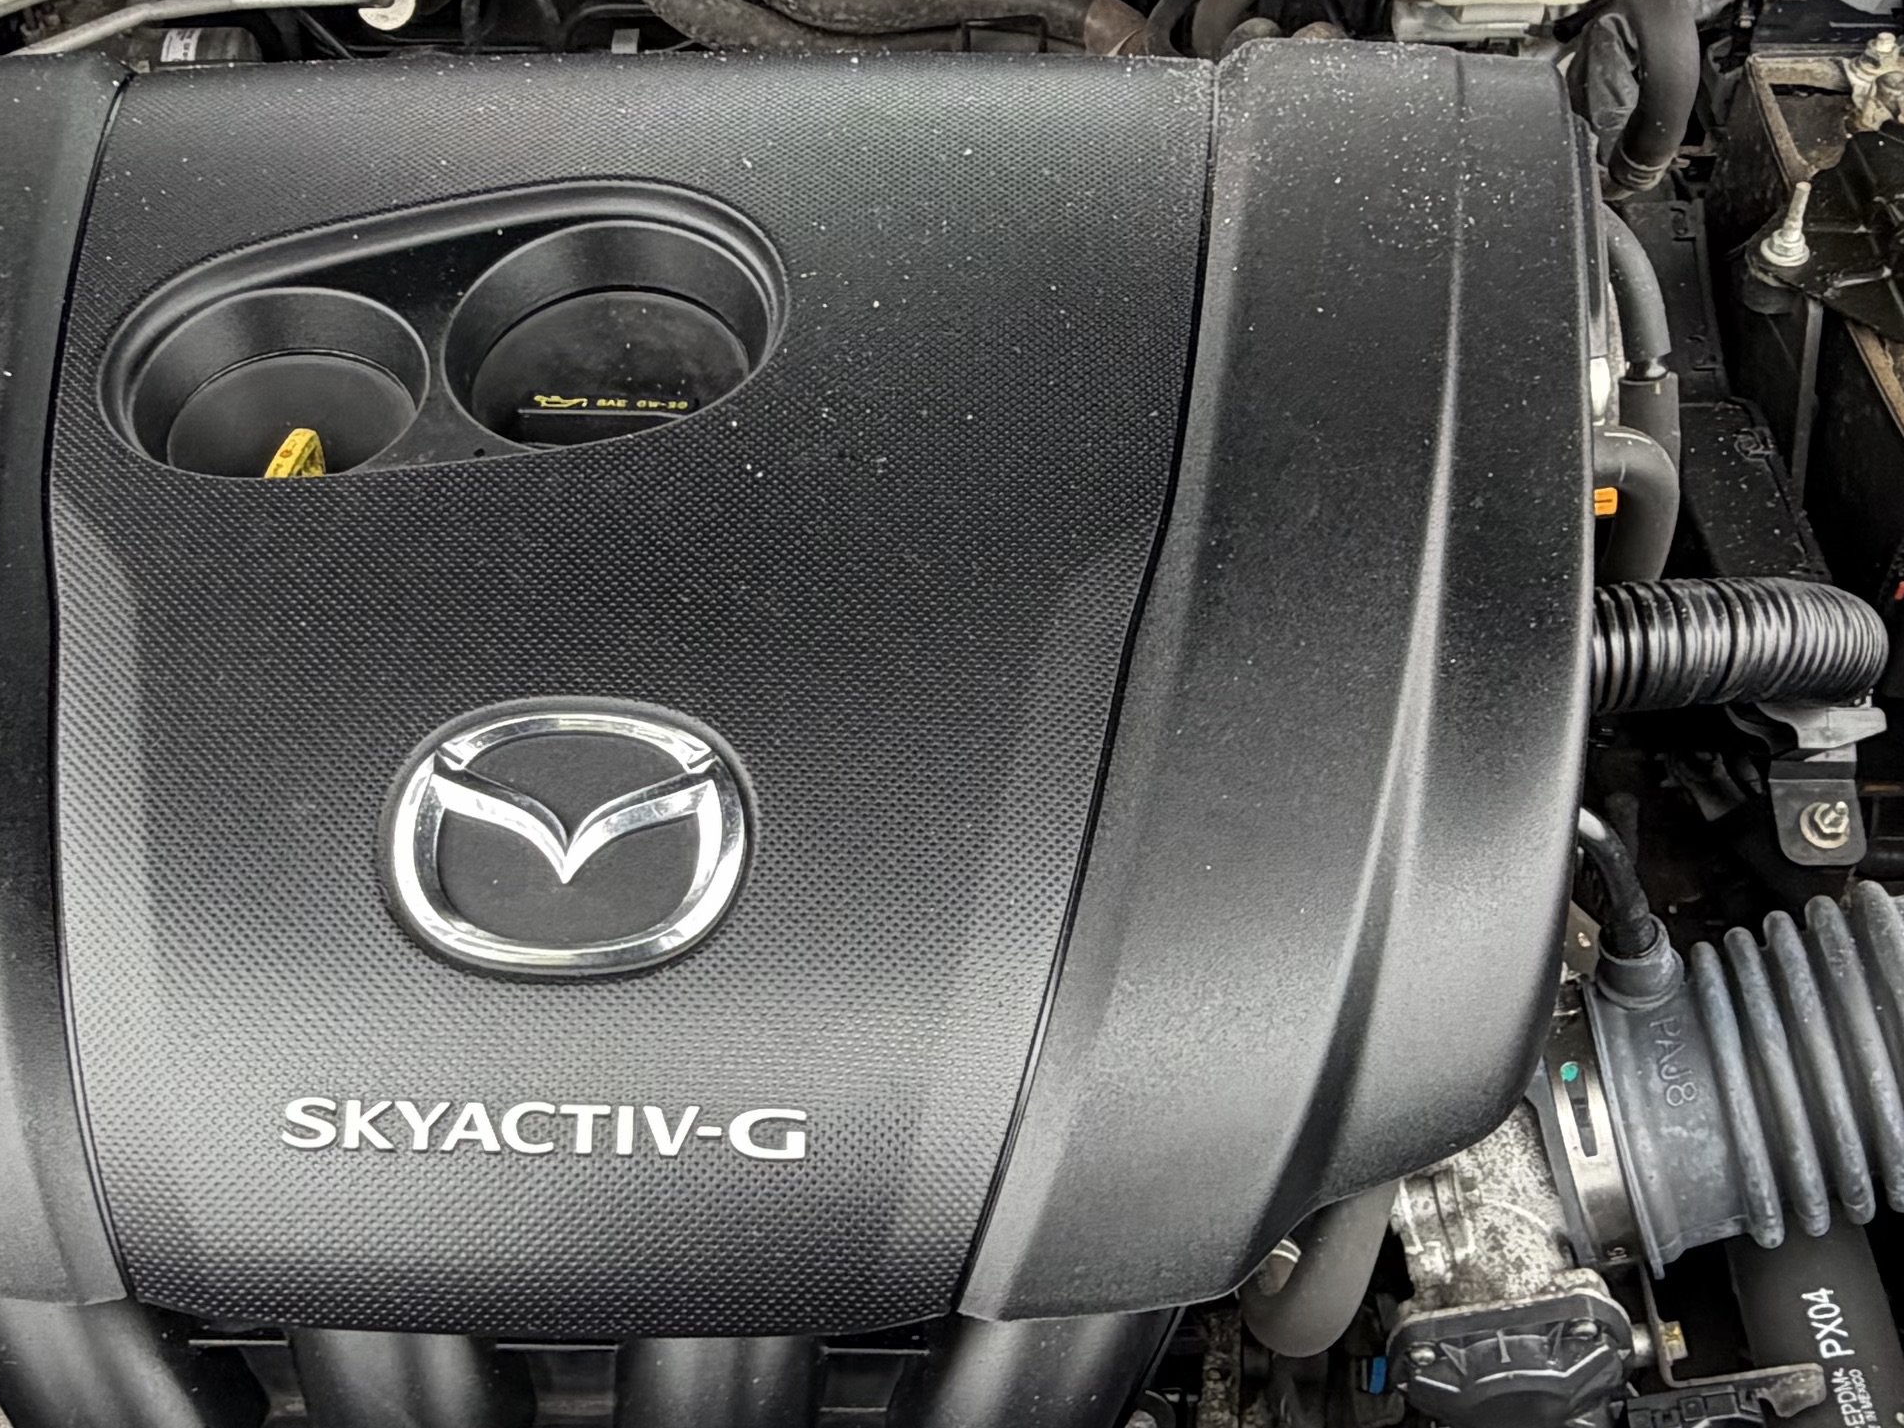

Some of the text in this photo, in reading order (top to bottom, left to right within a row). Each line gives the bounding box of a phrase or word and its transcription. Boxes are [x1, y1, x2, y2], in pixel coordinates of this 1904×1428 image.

[596, 398, 628, 408] SAE
[1649, 1015, 1697, 1107] PAJ8
[281, 1097, 808, 1160] SKYACTIV-G
[1801, 1287, 1856, 1359] PX04
[1848, 1368, 1874, 1410] MEXICO
[1865, 1410, 1878, 1422] IN
